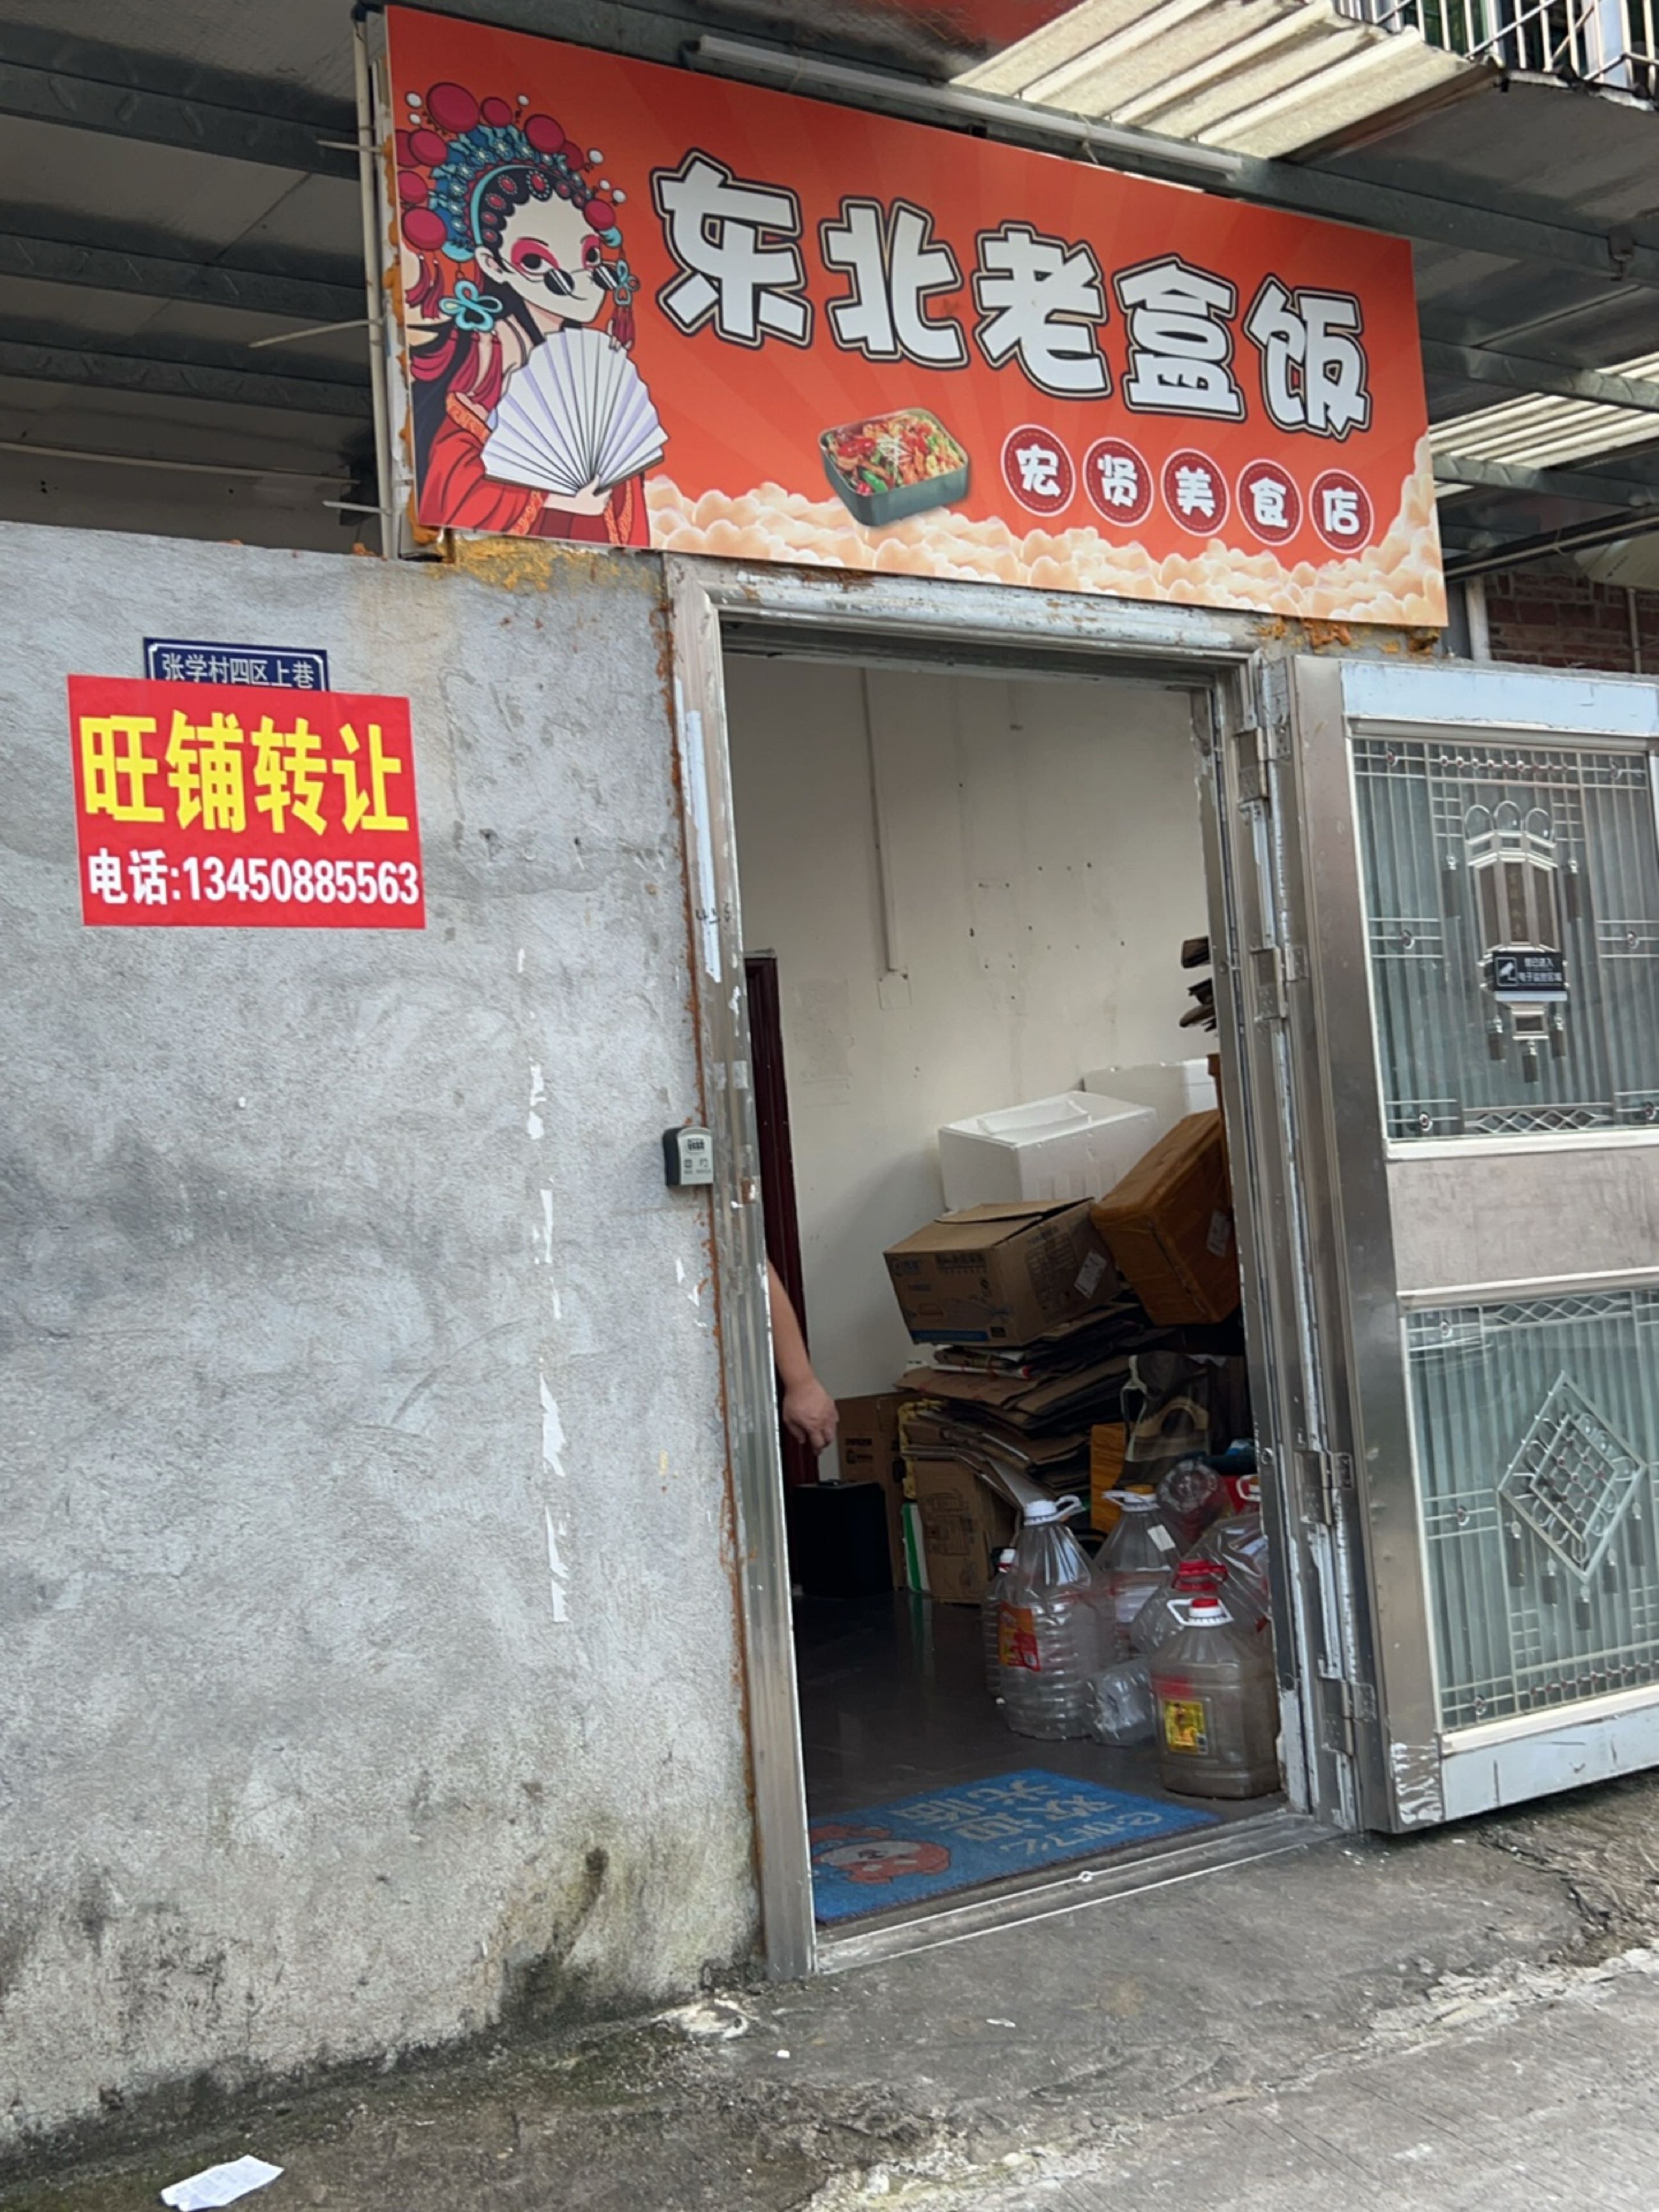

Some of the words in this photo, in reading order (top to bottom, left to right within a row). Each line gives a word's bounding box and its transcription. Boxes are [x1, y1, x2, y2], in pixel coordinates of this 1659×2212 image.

[652, 148, 1371, 439] 东北老盒饭
[1014, 443, 1361, 536] 宏贤美食店
[161, 652, 314, 689] 张学村四区上巷
[79, 709, 410, 836] 旺铺转让
[88, 848, 420, 906] 电话:13450885563
[886, 1778, 1061, 1829] 光临
[938, 1793, 1119, 1843] 欢迎
